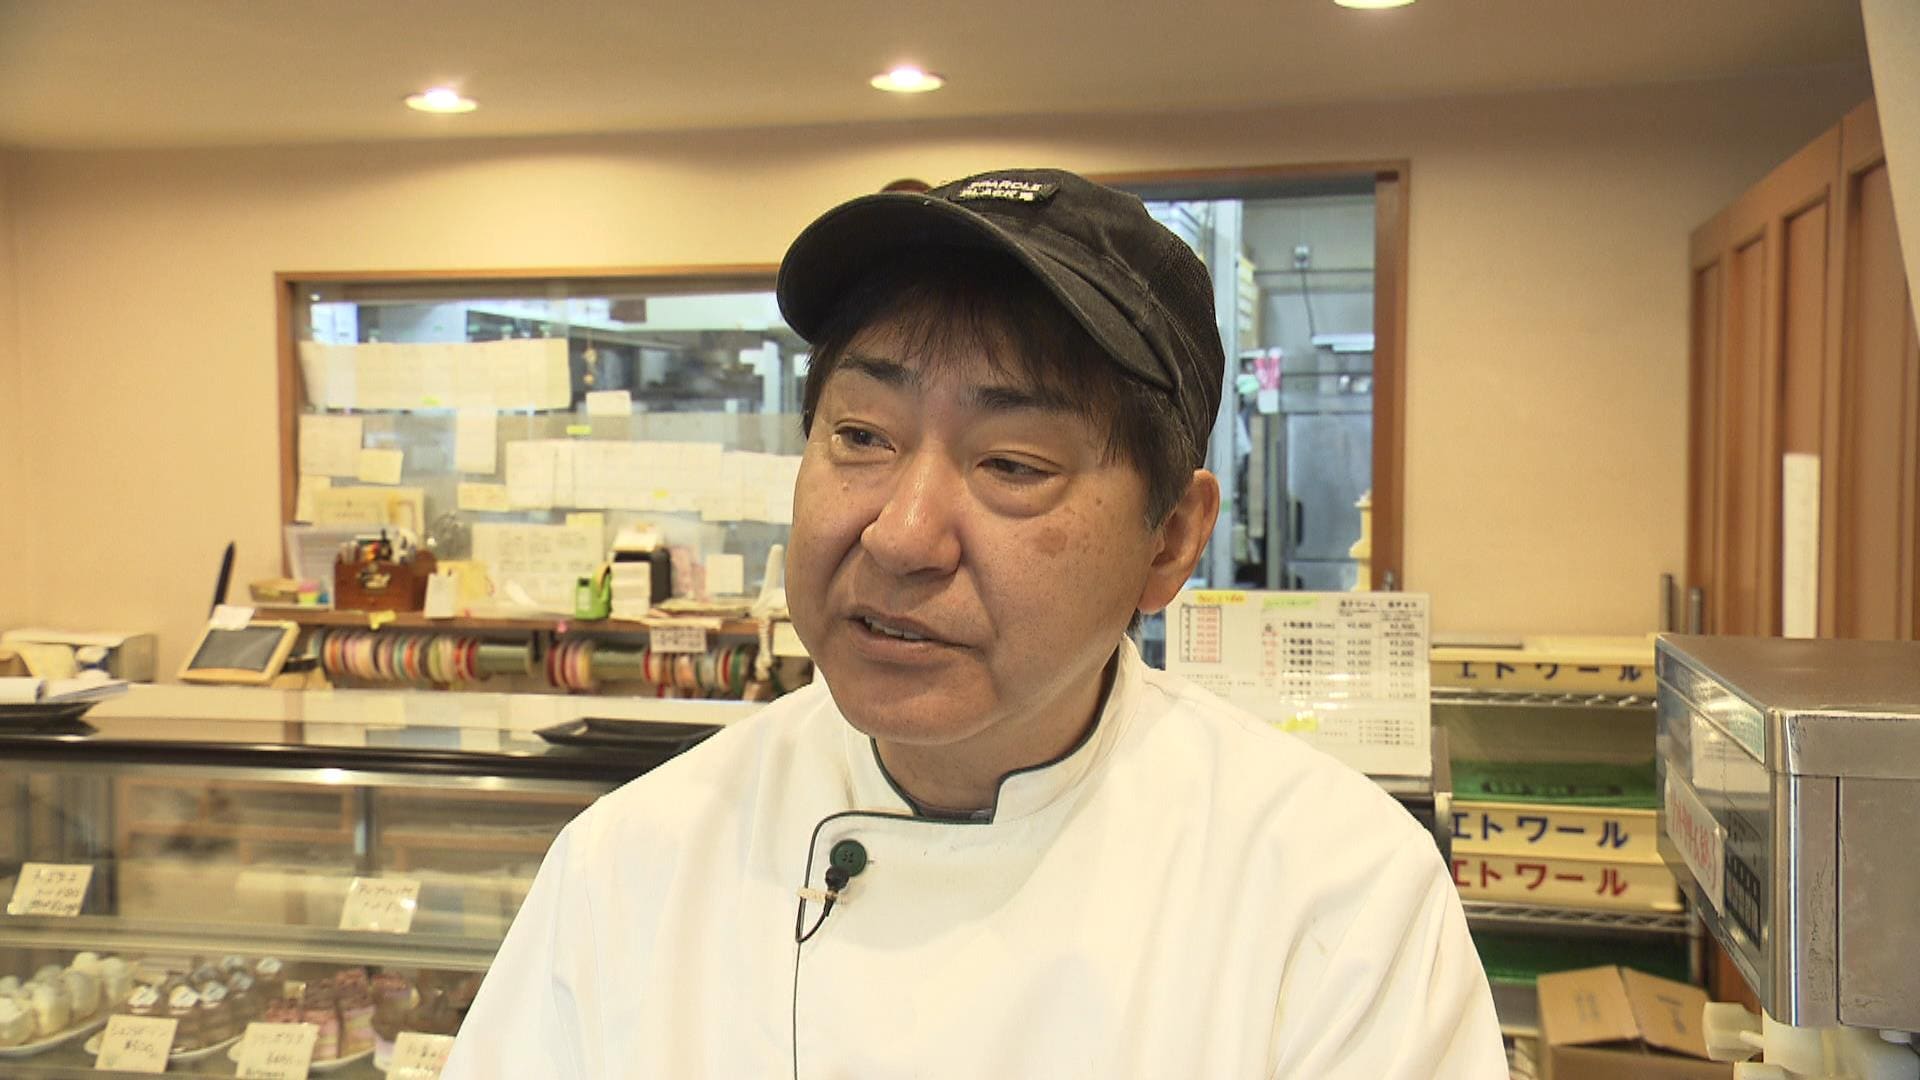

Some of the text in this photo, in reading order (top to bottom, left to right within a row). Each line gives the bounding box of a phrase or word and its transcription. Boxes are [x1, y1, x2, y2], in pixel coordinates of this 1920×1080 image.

[1457, 662, 1641, 682] エトワール
[1452, 812, 1629, 849] エトワール
[1452, 860, 1627, 897] エトワール
